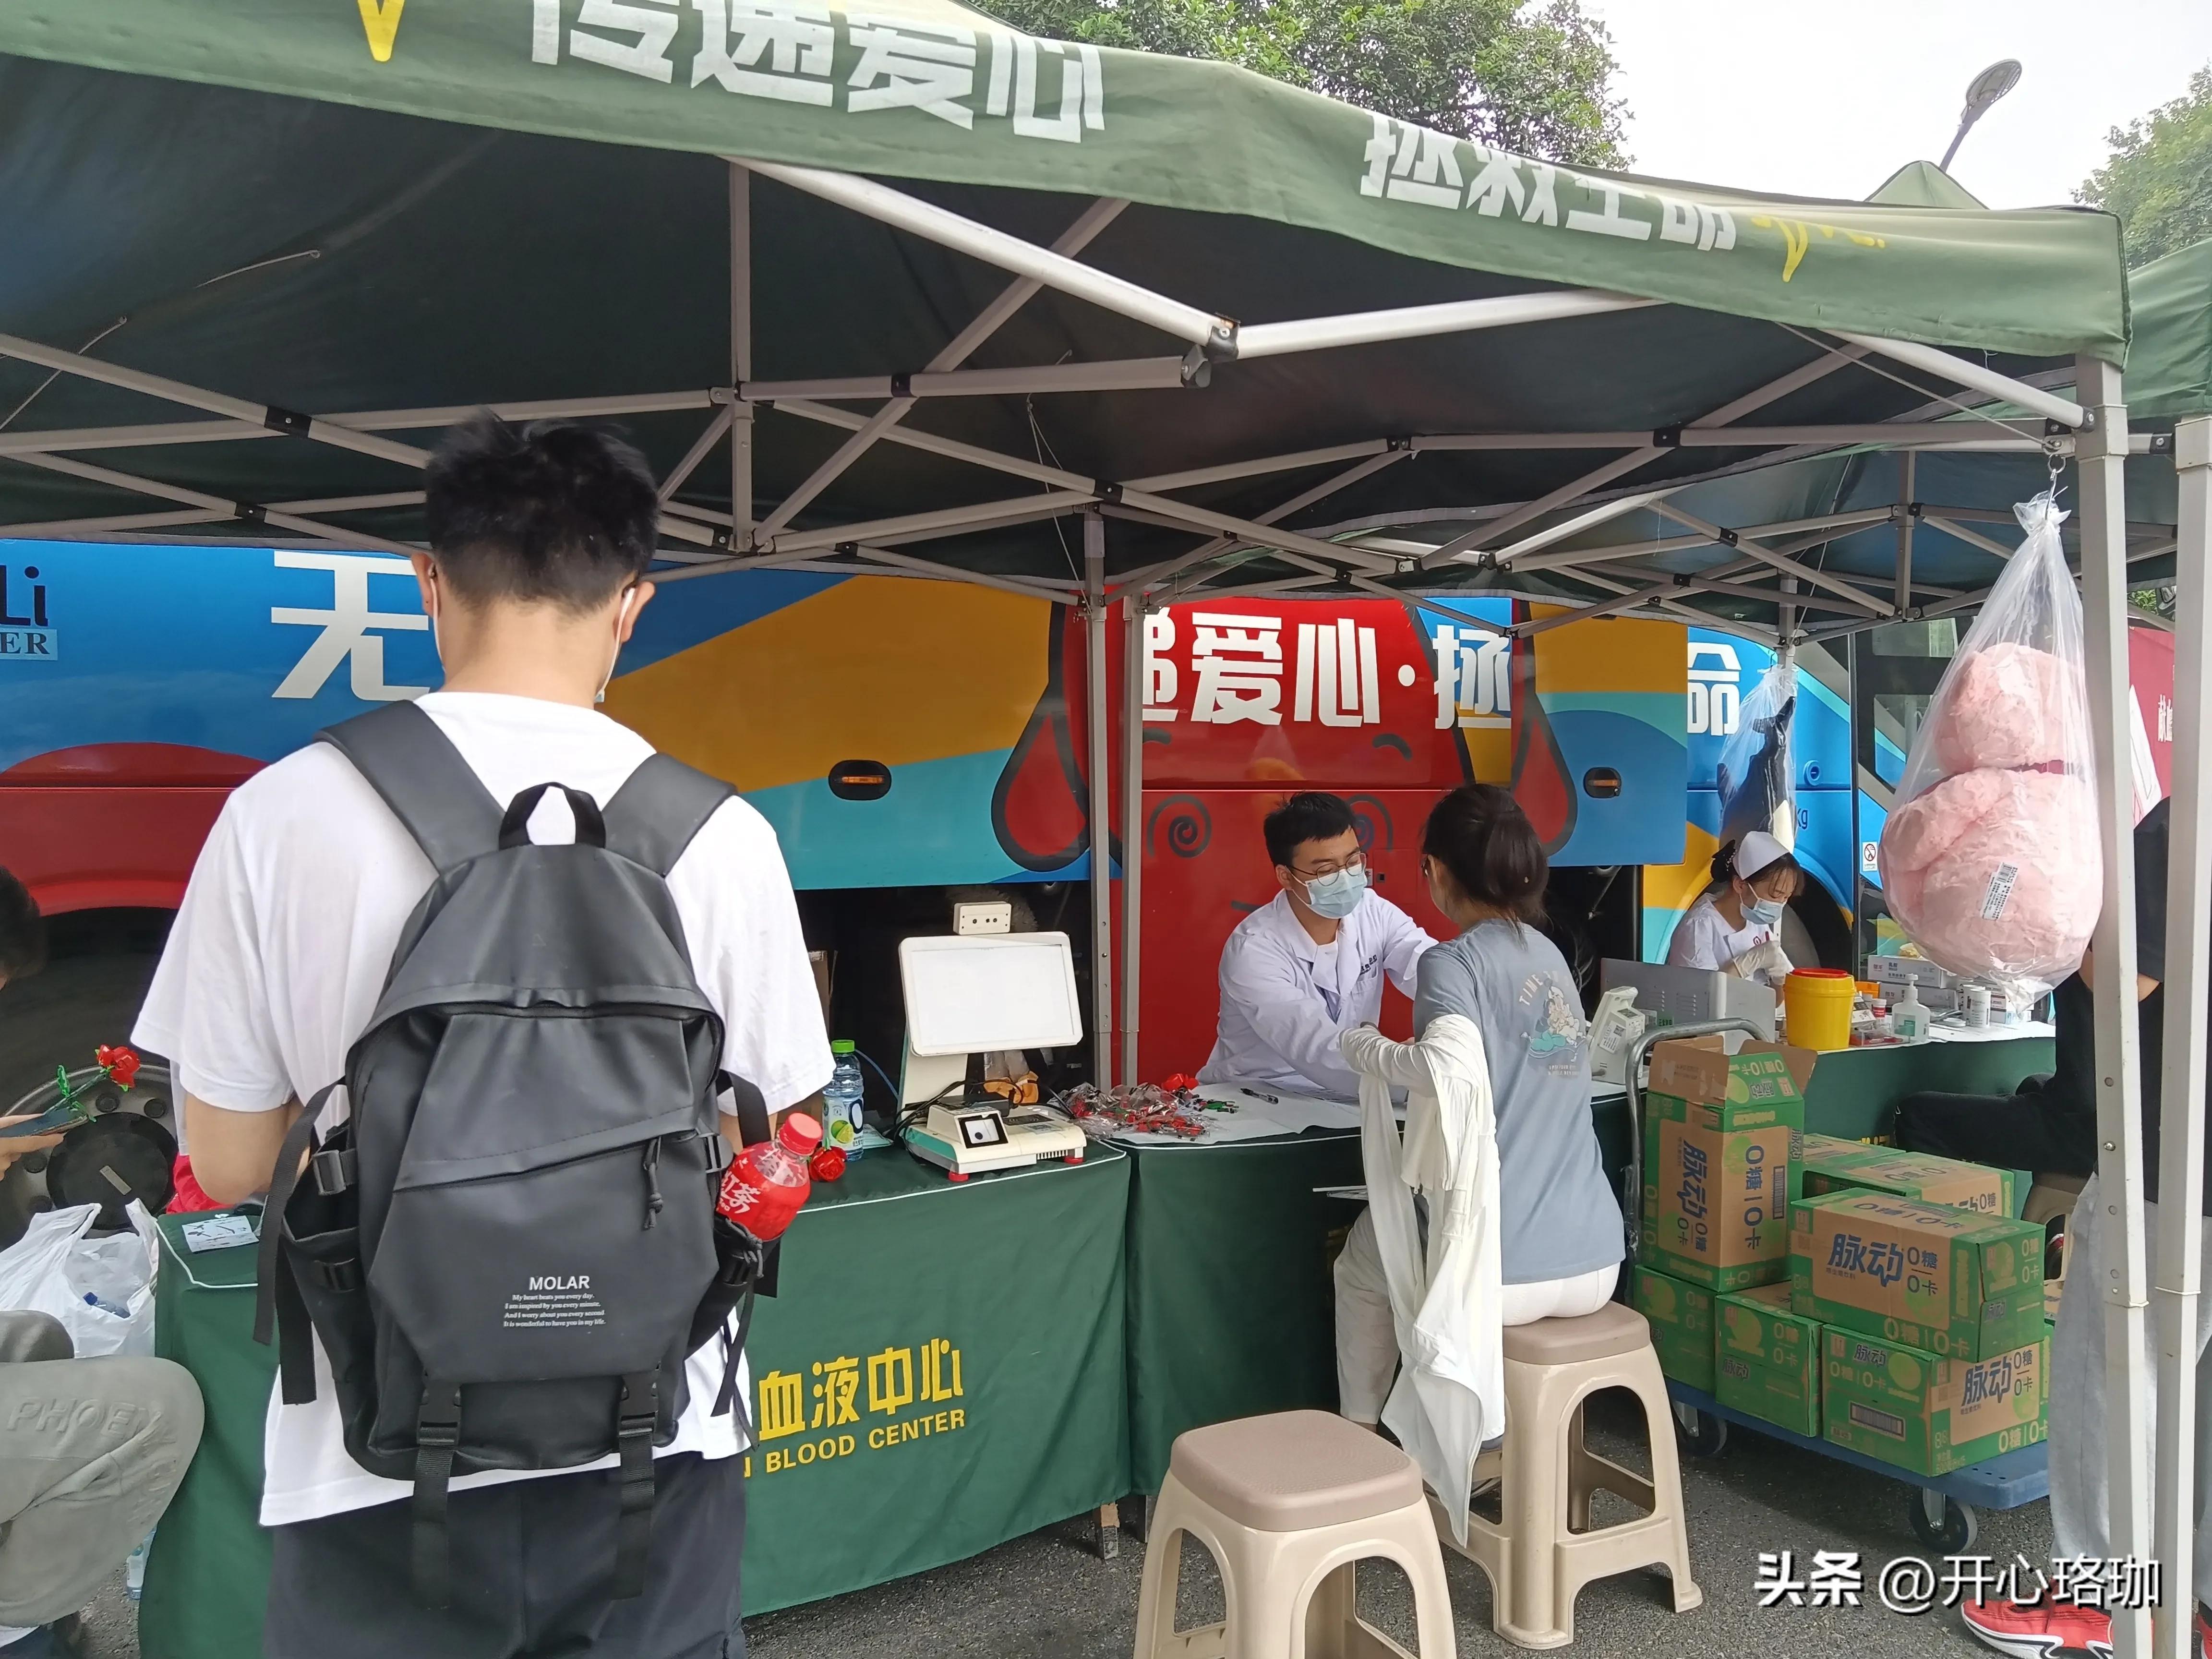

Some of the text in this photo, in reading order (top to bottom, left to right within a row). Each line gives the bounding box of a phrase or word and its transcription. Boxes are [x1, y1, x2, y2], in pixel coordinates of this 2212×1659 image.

[271, 551, 431, 701] 无
[0, 632, 50, 655] ER
[1677, 1139, 1707, 1219] 脉动
[1827, 1234, 1903, 1287] 脉动
[1907, 1247, 1938, 1269] 0糖
[529, 1275, 590, 1290] MOLAR
[1907, 1275, 1938, 1296] 0卡
[1854, 1344, 1887, 1367] 脉动
[2014, 1349, 2032, 1369] 0糖
[1723, 1358, 1750, 1381] 脉动
[1961, 1355, 2012, 1407] 脉动
[759, 1338, 963, 1441] 血液中心
[2014, 1376, 2033, 1396] 0卡
[766, 1435, 855, 1473] BLOOD
[868, 1408, 965, 1449] CENTER
